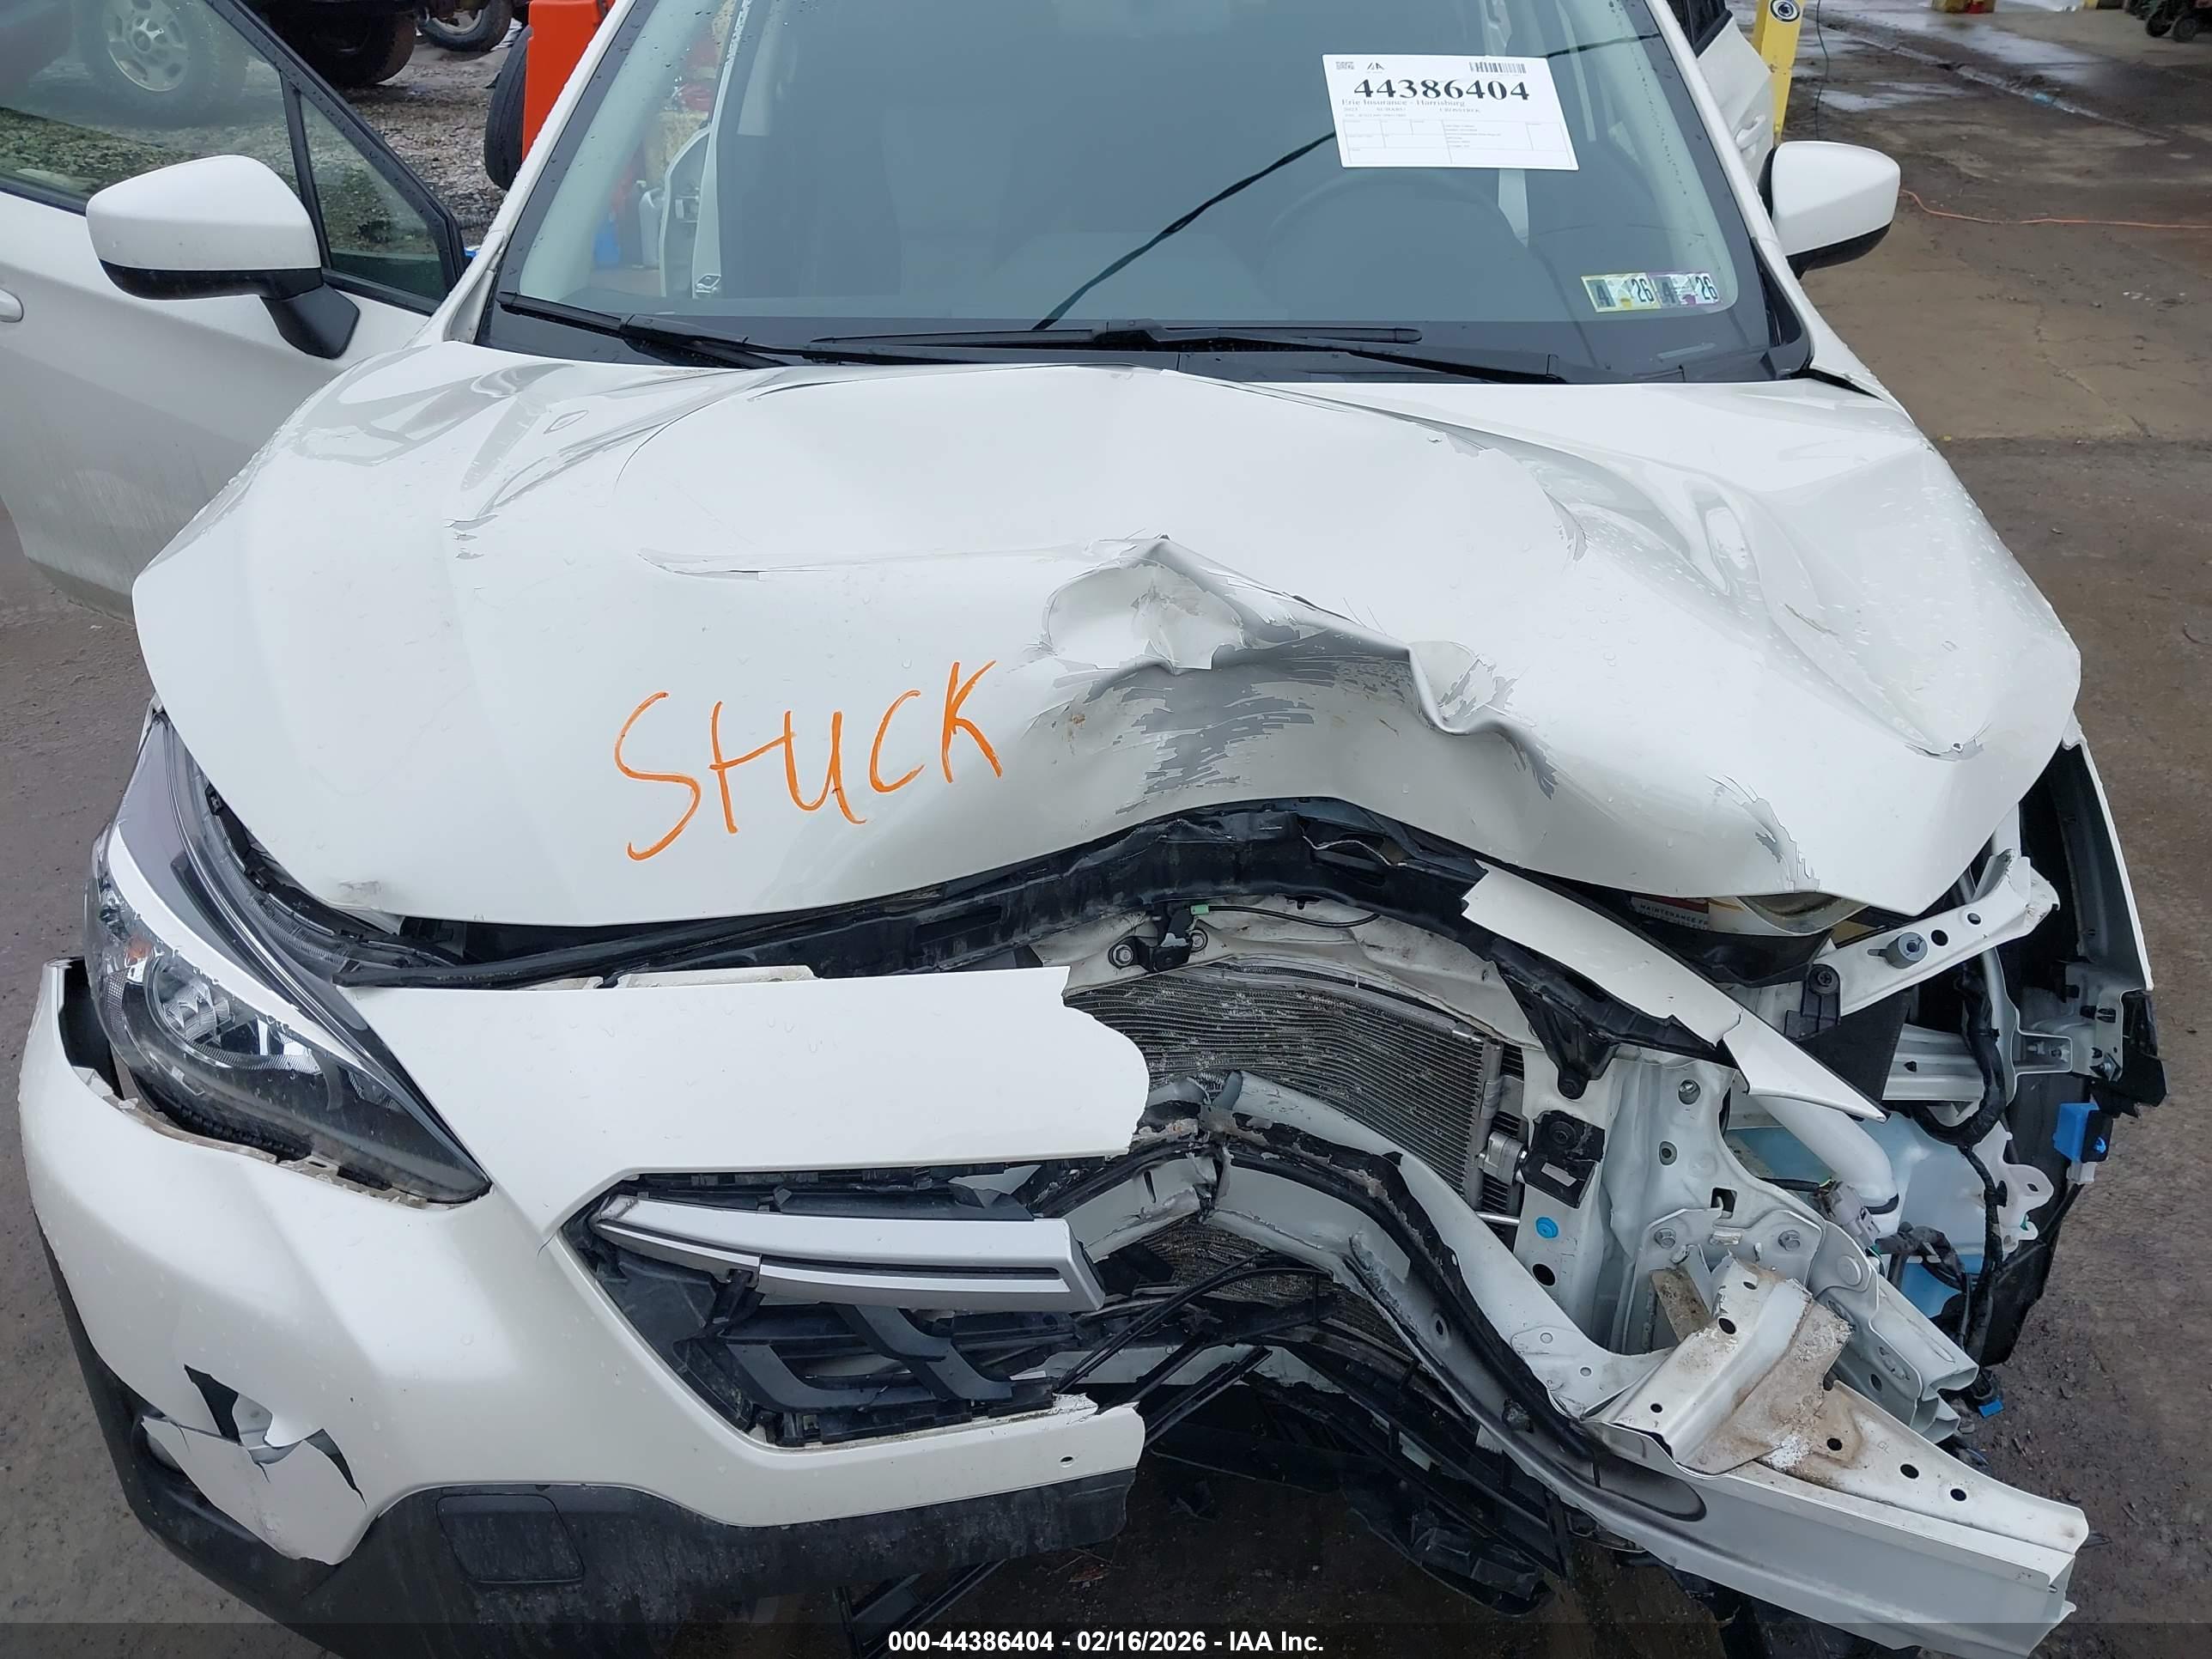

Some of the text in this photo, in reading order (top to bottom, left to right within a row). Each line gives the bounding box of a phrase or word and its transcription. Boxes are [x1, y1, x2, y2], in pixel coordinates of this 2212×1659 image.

[1354, 79, 1529, 100] 44386404
[1416, 99, 1466, 108] Harrisburg
[1631, 277, 1656, 303] 26
[1694, 276, 1719, 301] 26
